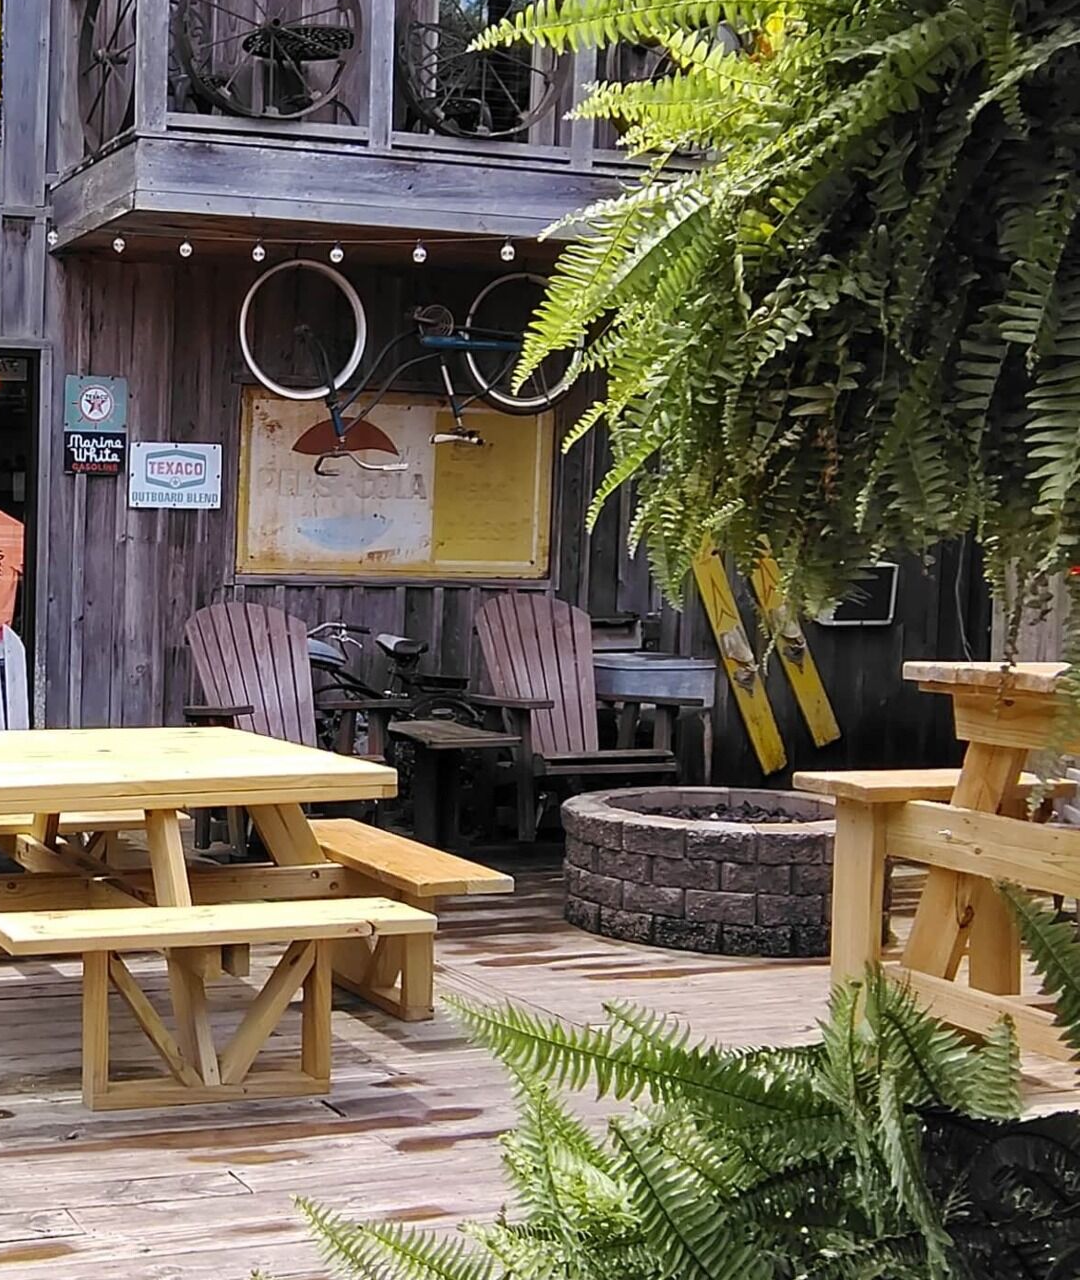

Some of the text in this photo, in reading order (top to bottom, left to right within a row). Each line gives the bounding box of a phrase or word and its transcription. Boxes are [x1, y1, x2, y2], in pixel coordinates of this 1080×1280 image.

[67, 434, 124, 448] Marine
[70, 447, 121, 462] White
[72, 462, 118, 472] GASOLINE
[149, 460, 203, 476] TEXACO
[132, 491, 219, 504] OUTBOARD BLEND
